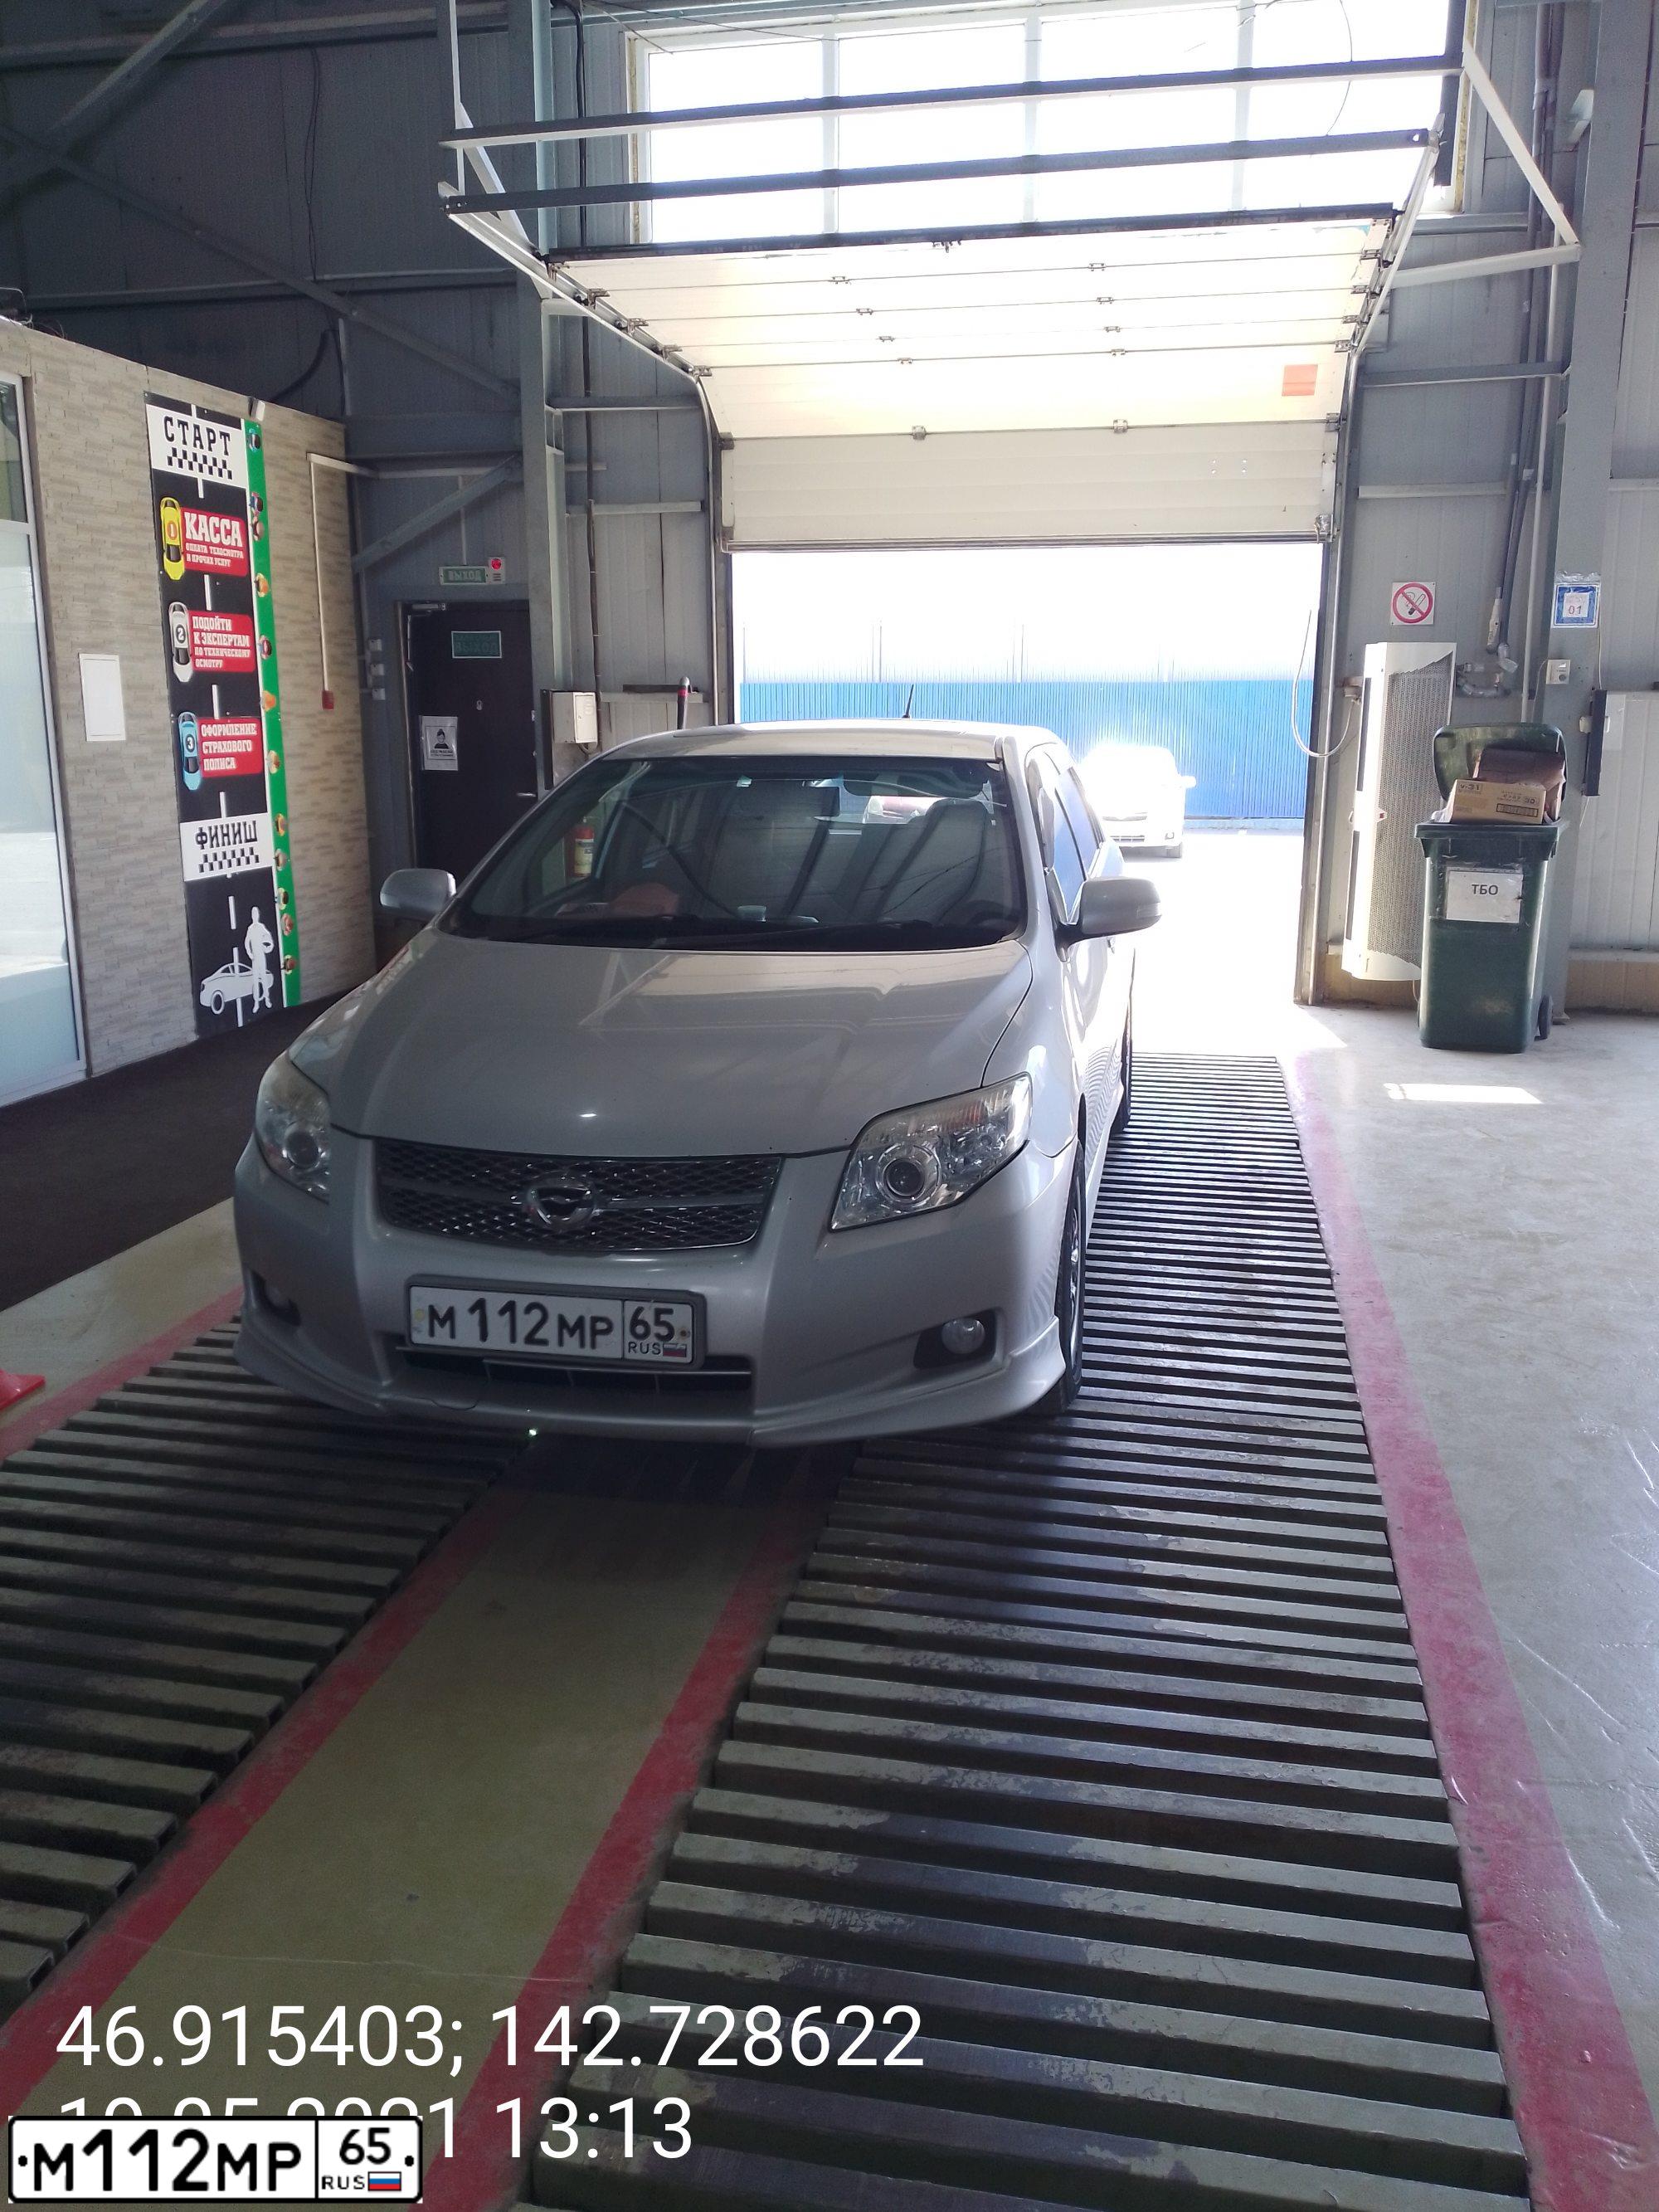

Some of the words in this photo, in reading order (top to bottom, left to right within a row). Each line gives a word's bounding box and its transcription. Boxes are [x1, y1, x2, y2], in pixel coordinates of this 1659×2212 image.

[163, 416, 231, 456] СТАРТ
[170, 524, 175, 537] 1
[184, 511, 242, 547] КАССА
[1569, 605, 1582, 615] 01
[192, 616, 232, 631] ПОДОЙТИ
[178, 627, 183, 641] 2
[193, 631, 201, 644] К
[201, 632, 251, 646] ЭКСПЕРТАМ
[194, 647, 203, 655] ПО
[203, 647, 251, 657] ТЕХНИЧЕСКОМУ
[195, 659, 223, 668] ОСМОТРУ
[201, 724, 257, 737] ОФОРМЛЕНИЕ
[187, 737, 193, 749] 3
[202, 740, 252, 754] СТРАХОВОГО
[203, 758, 236, 771] ПОЛИСА
[195, 820, 257, 850] ФИНИШ
[1472, 883, 1498, 895] ТБО
[428, 1297, 614, 1350] М112МР
[629, 1306, 675, 1342] 65
[628, 1342, 661, 1355] RUS
